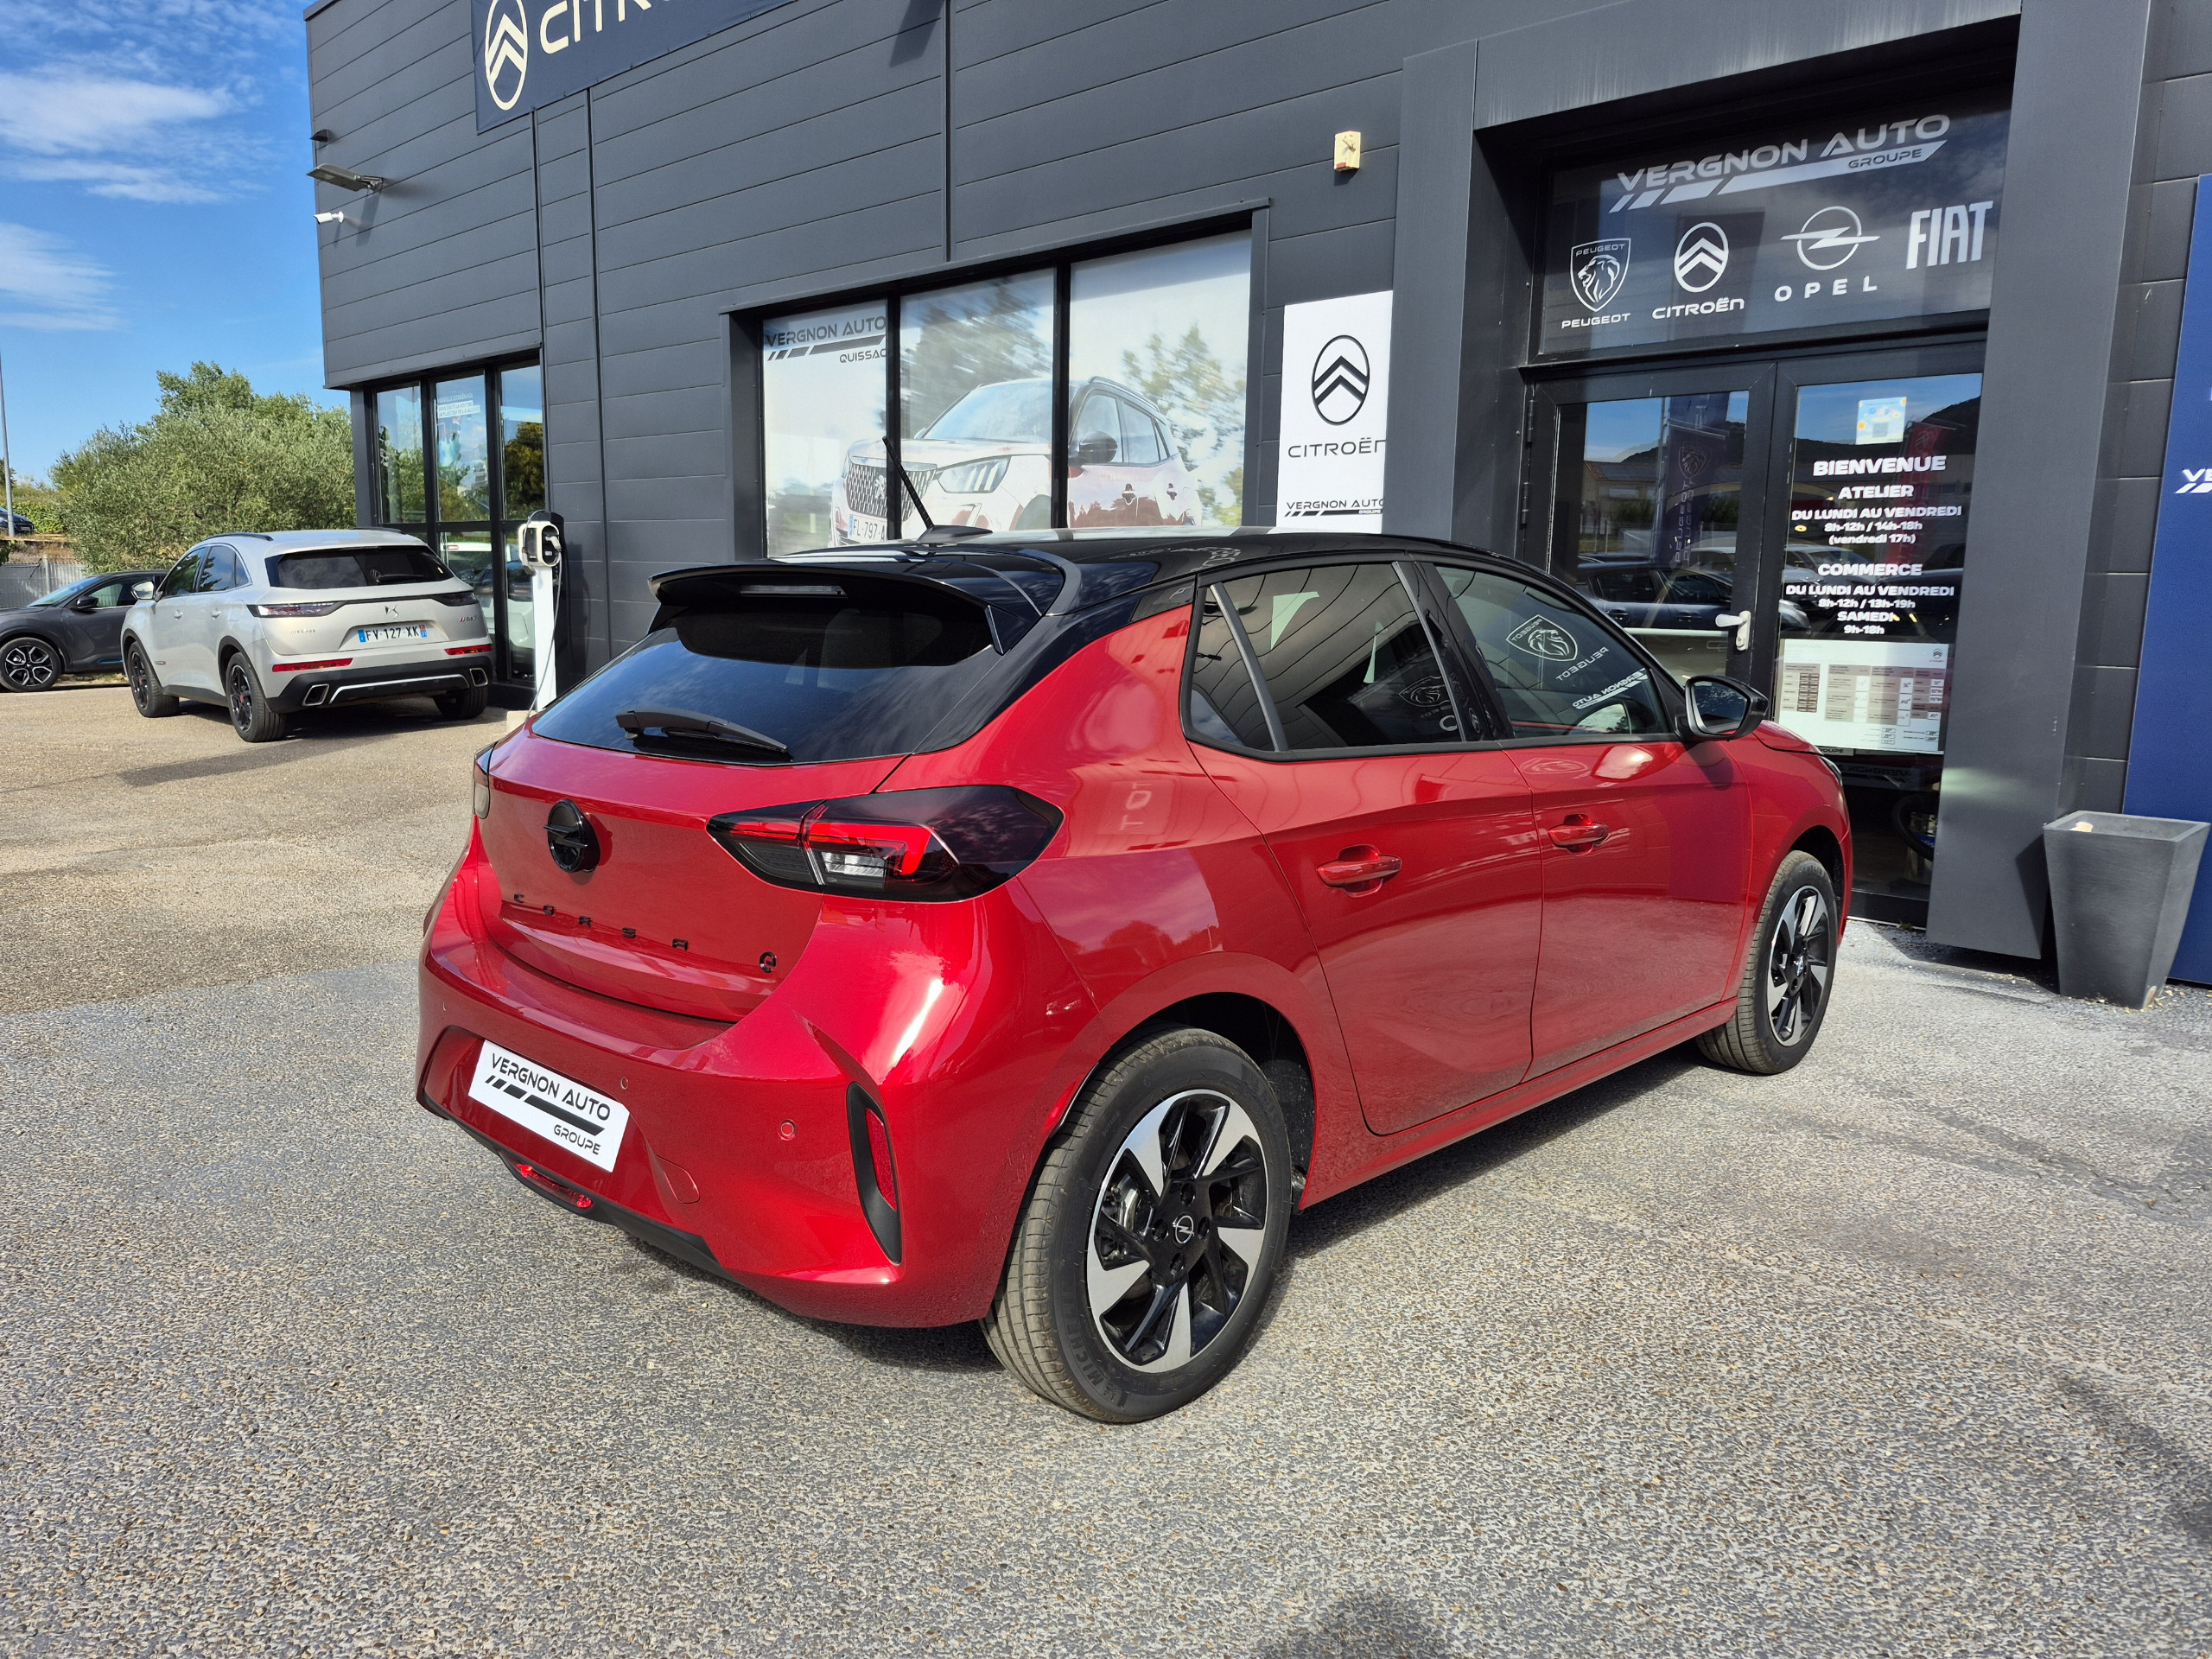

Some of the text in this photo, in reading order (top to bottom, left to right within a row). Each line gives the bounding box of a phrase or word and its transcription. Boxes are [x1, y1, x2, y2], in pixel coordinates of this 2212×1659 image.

[1617, 114, 1951, 192] VERGNON AUTO
[1847, 148, 1923, 170] GROUPE
[1905, 200, 1993, 270] FIAT
[1575, 243, 1625, 257] PEUGEOT
[1774, 275, 1878, 302] OPEL
[1561, 312, 1630, 329] PEUGEOT
[766, 315, 886, 347] VERGNON AUTO
[1813, 455, 1947, 476] BIENVENUE
[1838, 485, 1915, 499] ATELIER
[1286, 499, 1347, 511] VERGNON
[1791, 505, 1962, 521] DU LUNDI AU VENDREDI
[1824, 522, 1866, 532] 8h-12h
[1874, 520, 1923, 531] 14h-18h
[1828, 533, 1916, 545] (vendredi 17h)
[1817, 563, 1923, 576] COMMERCE
[1786, 584, 1955, 596] DU LUNDI AU VENDREDI
[1818, 598, 1859, 608] 8h-12h
[1867, 599, 1916, 608] 13h-19h
[1837, 611, 1893, 622] SAMEDI
[365, 626, 419, 641] FV-127-XK
[1843, 624, 1885, 634] 9h-18h
[492, 1052, 611, 1121] VERGNON AUTO
[553, 1124, 601, 1155] GROUPE
